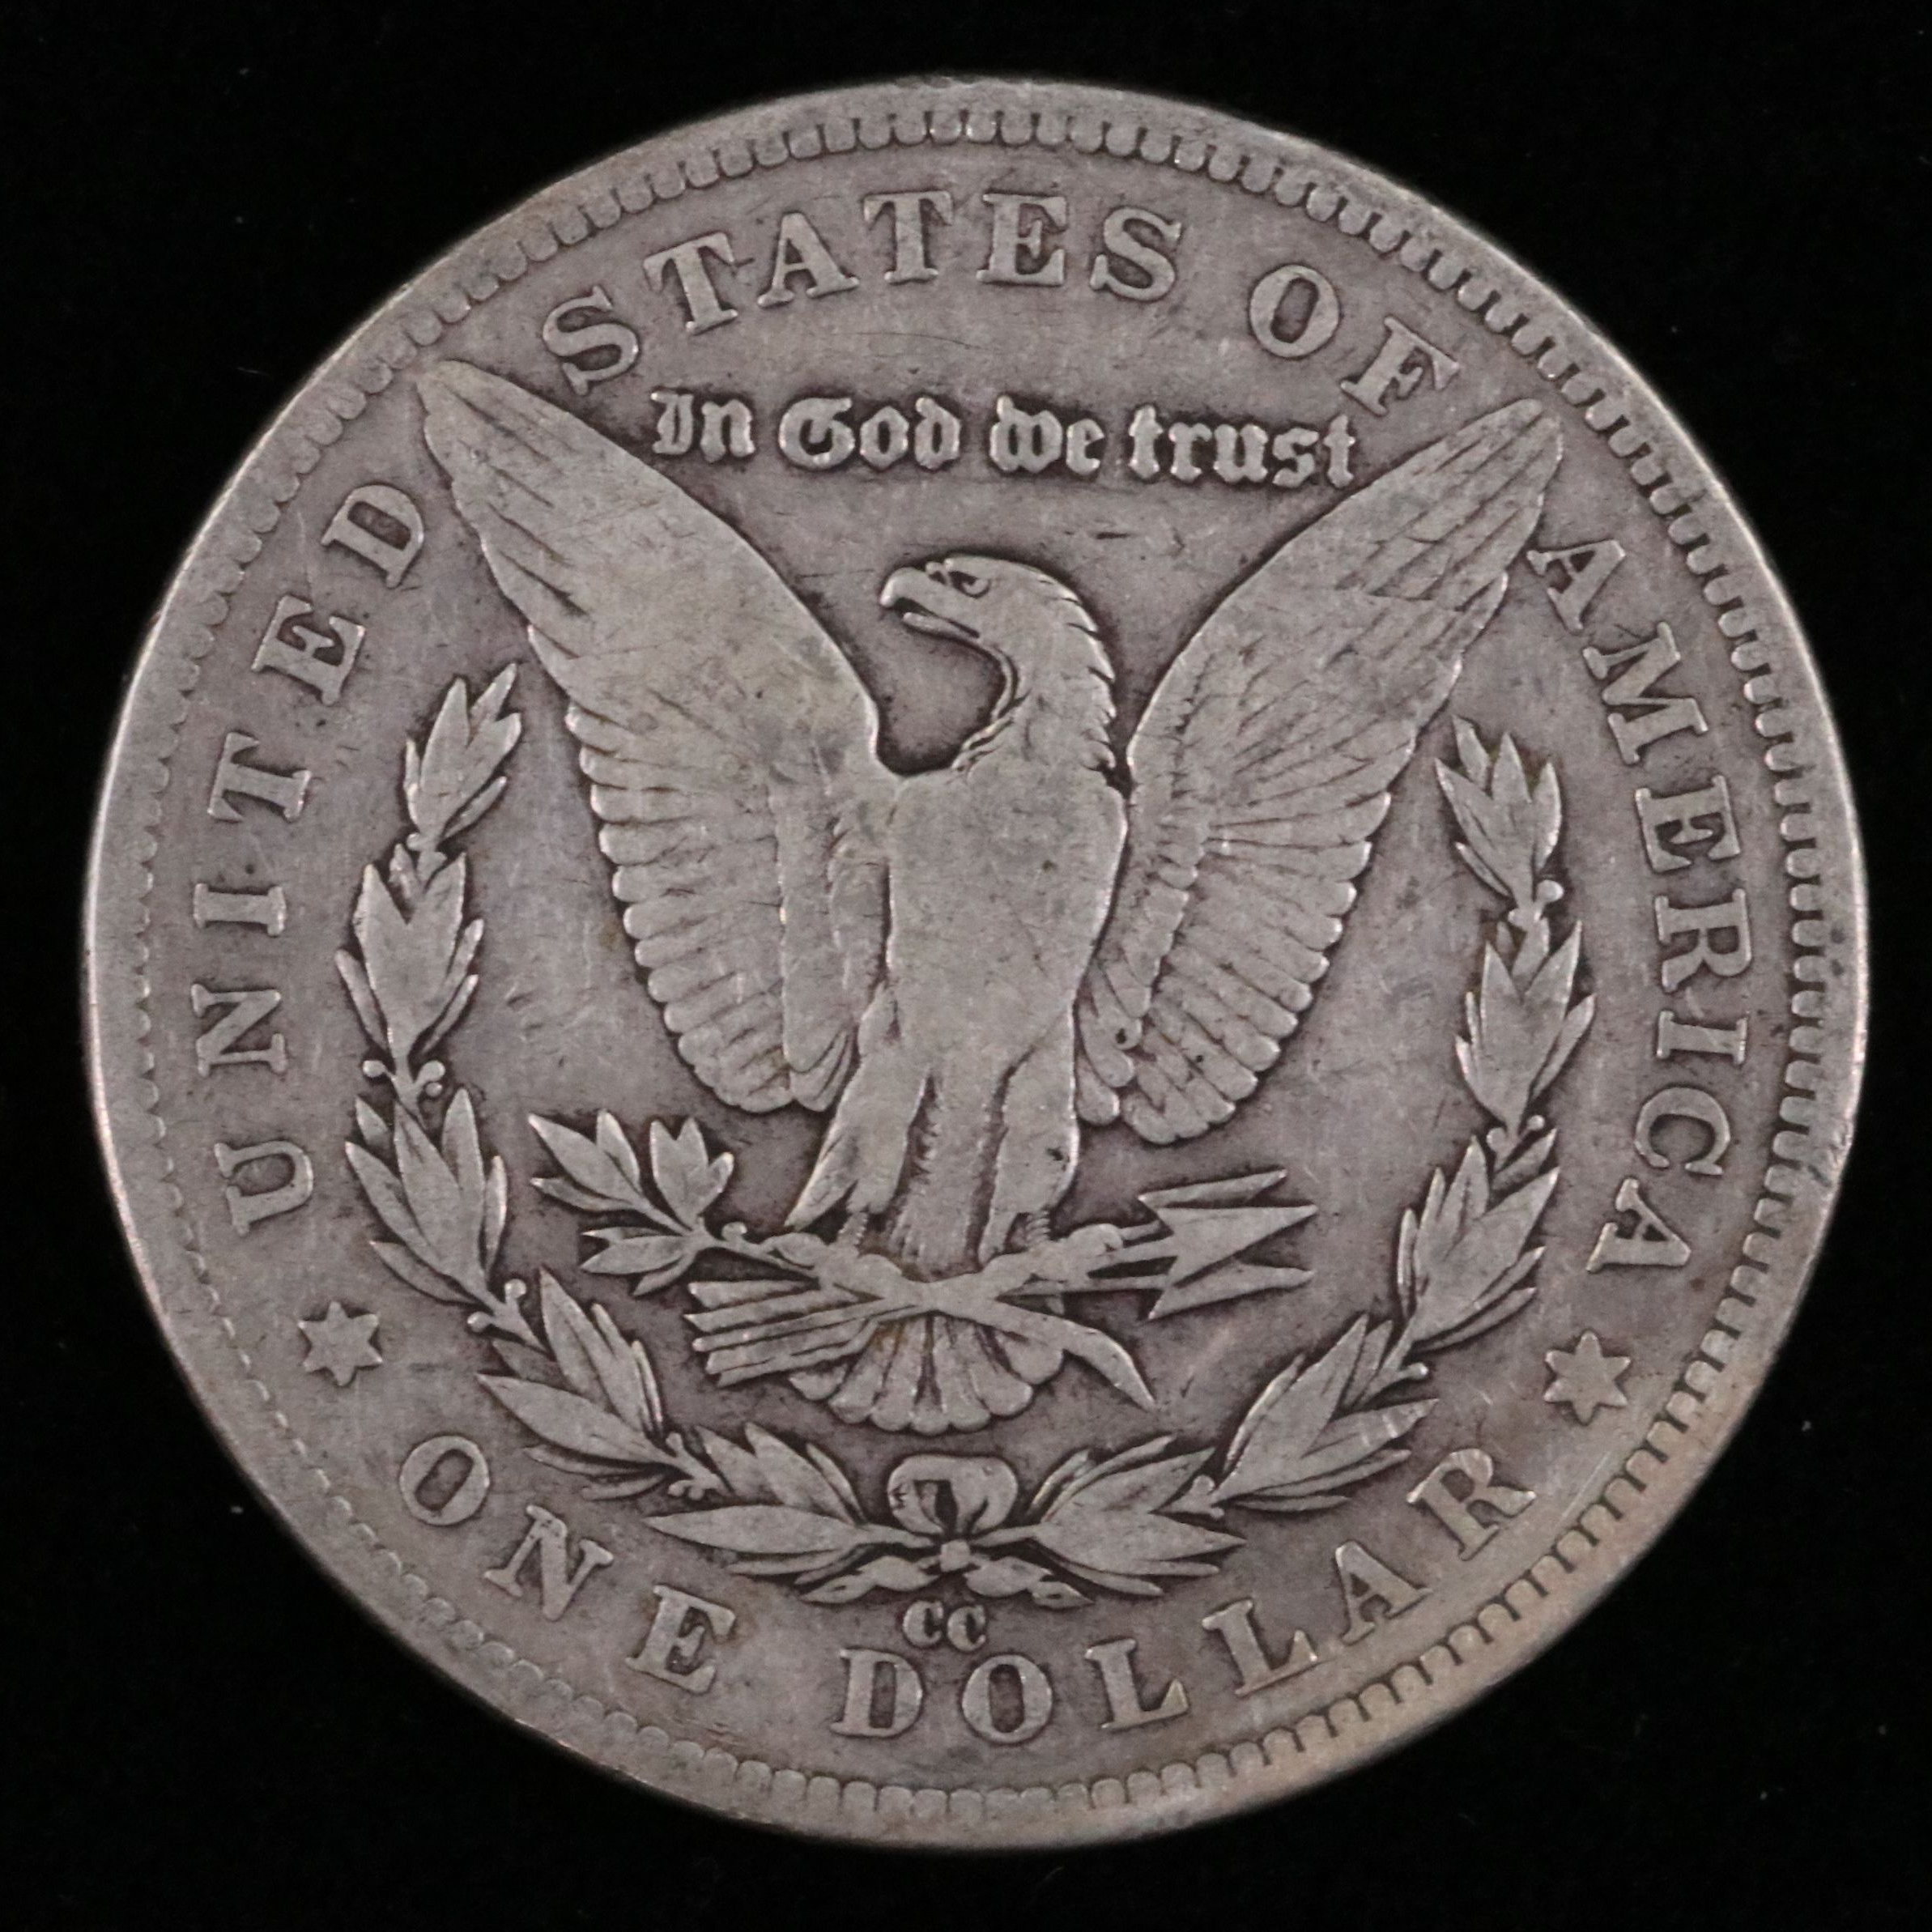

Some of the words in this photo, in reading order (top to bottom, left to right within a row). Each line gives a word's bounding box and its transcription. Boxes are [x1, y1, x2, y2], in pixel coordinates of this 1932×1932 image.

[650, 390, 755, 462] In
[778, 396, 961, 470] God
[989, 394, 1105, 475] we
[1129, 405, 1357, 491] trust
[190, 484, 425, 1235] UNITED
[542, 189, 1183, 395] STATES
[1249, 265, 1460, 416] OF
[1526, 538, 1754, 1274] AMERICA
[398, 1435, 736, 1694] ONE
[829, 1448, 1536, 1743] DOLLAR
